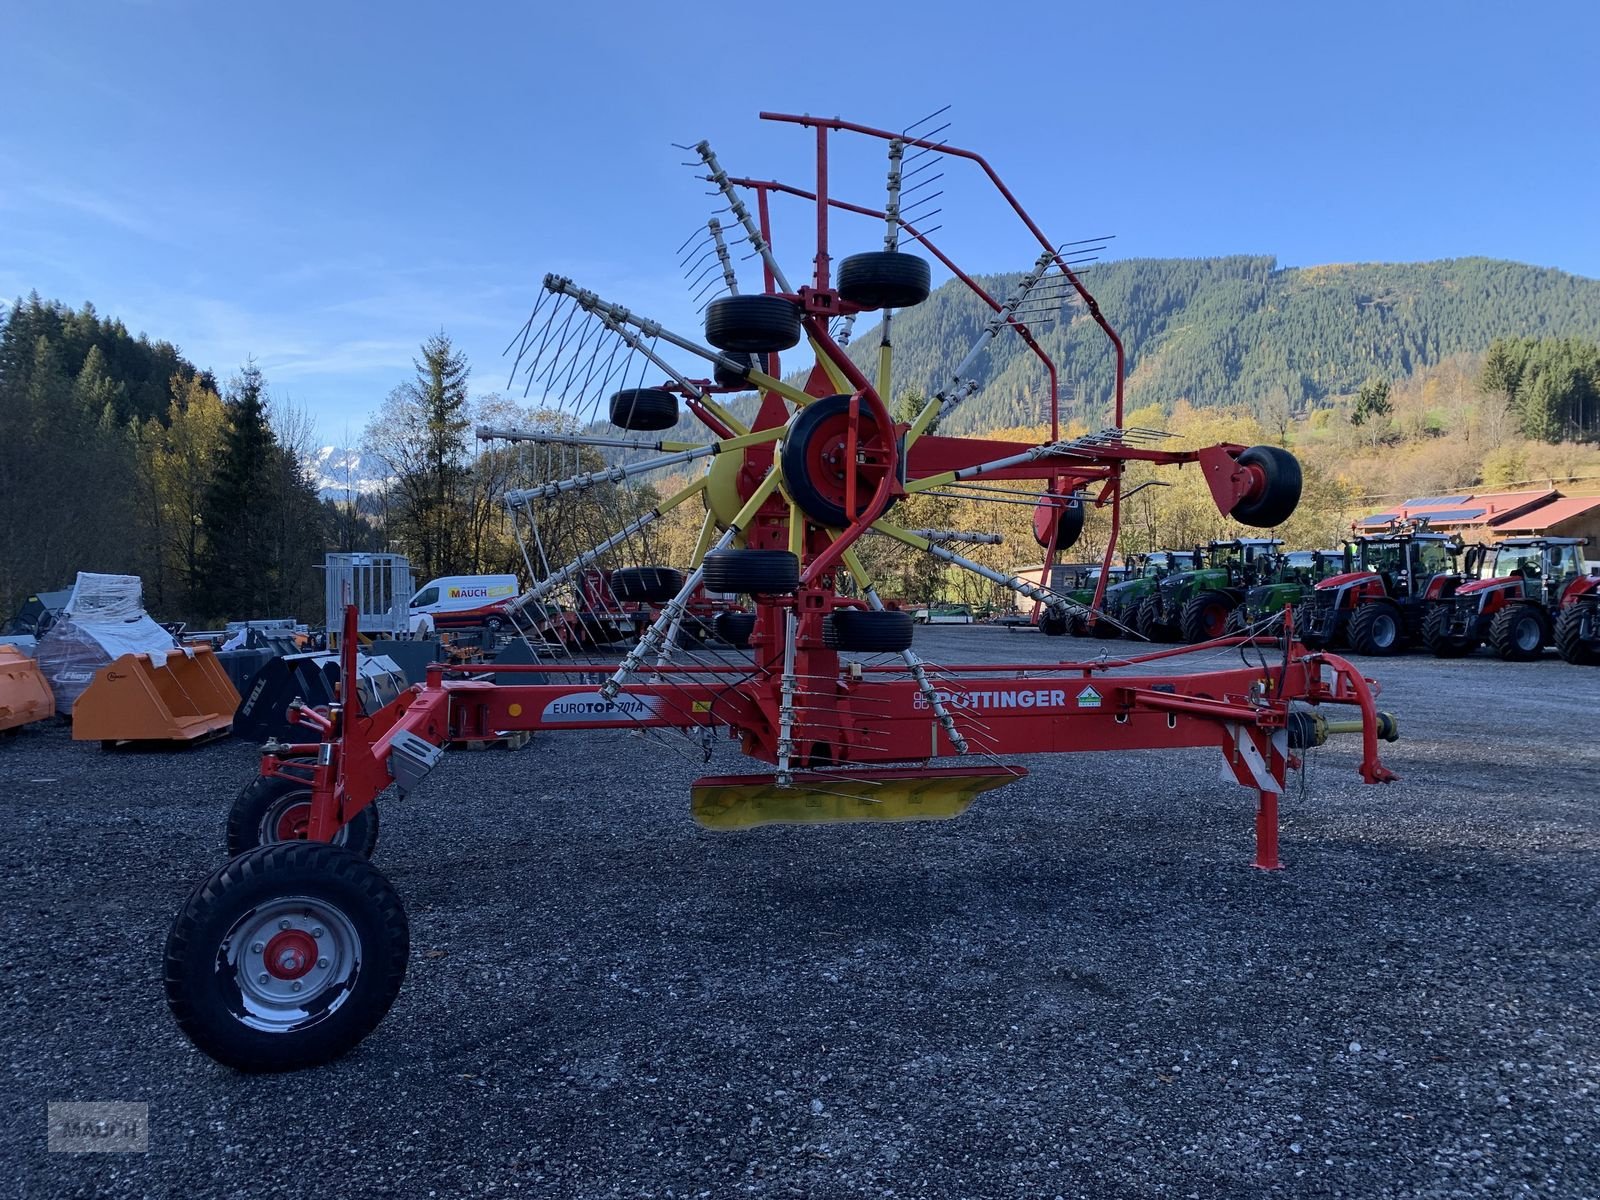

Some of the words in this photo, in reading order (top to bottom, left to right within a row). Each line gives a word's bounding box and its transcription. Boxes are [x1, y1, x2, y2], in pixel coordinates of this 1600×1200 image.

[451, 589, 488, 598] MAUCH
[242, 678, 268, 717] STOLL
[617, 701, 643, 713] 701A
